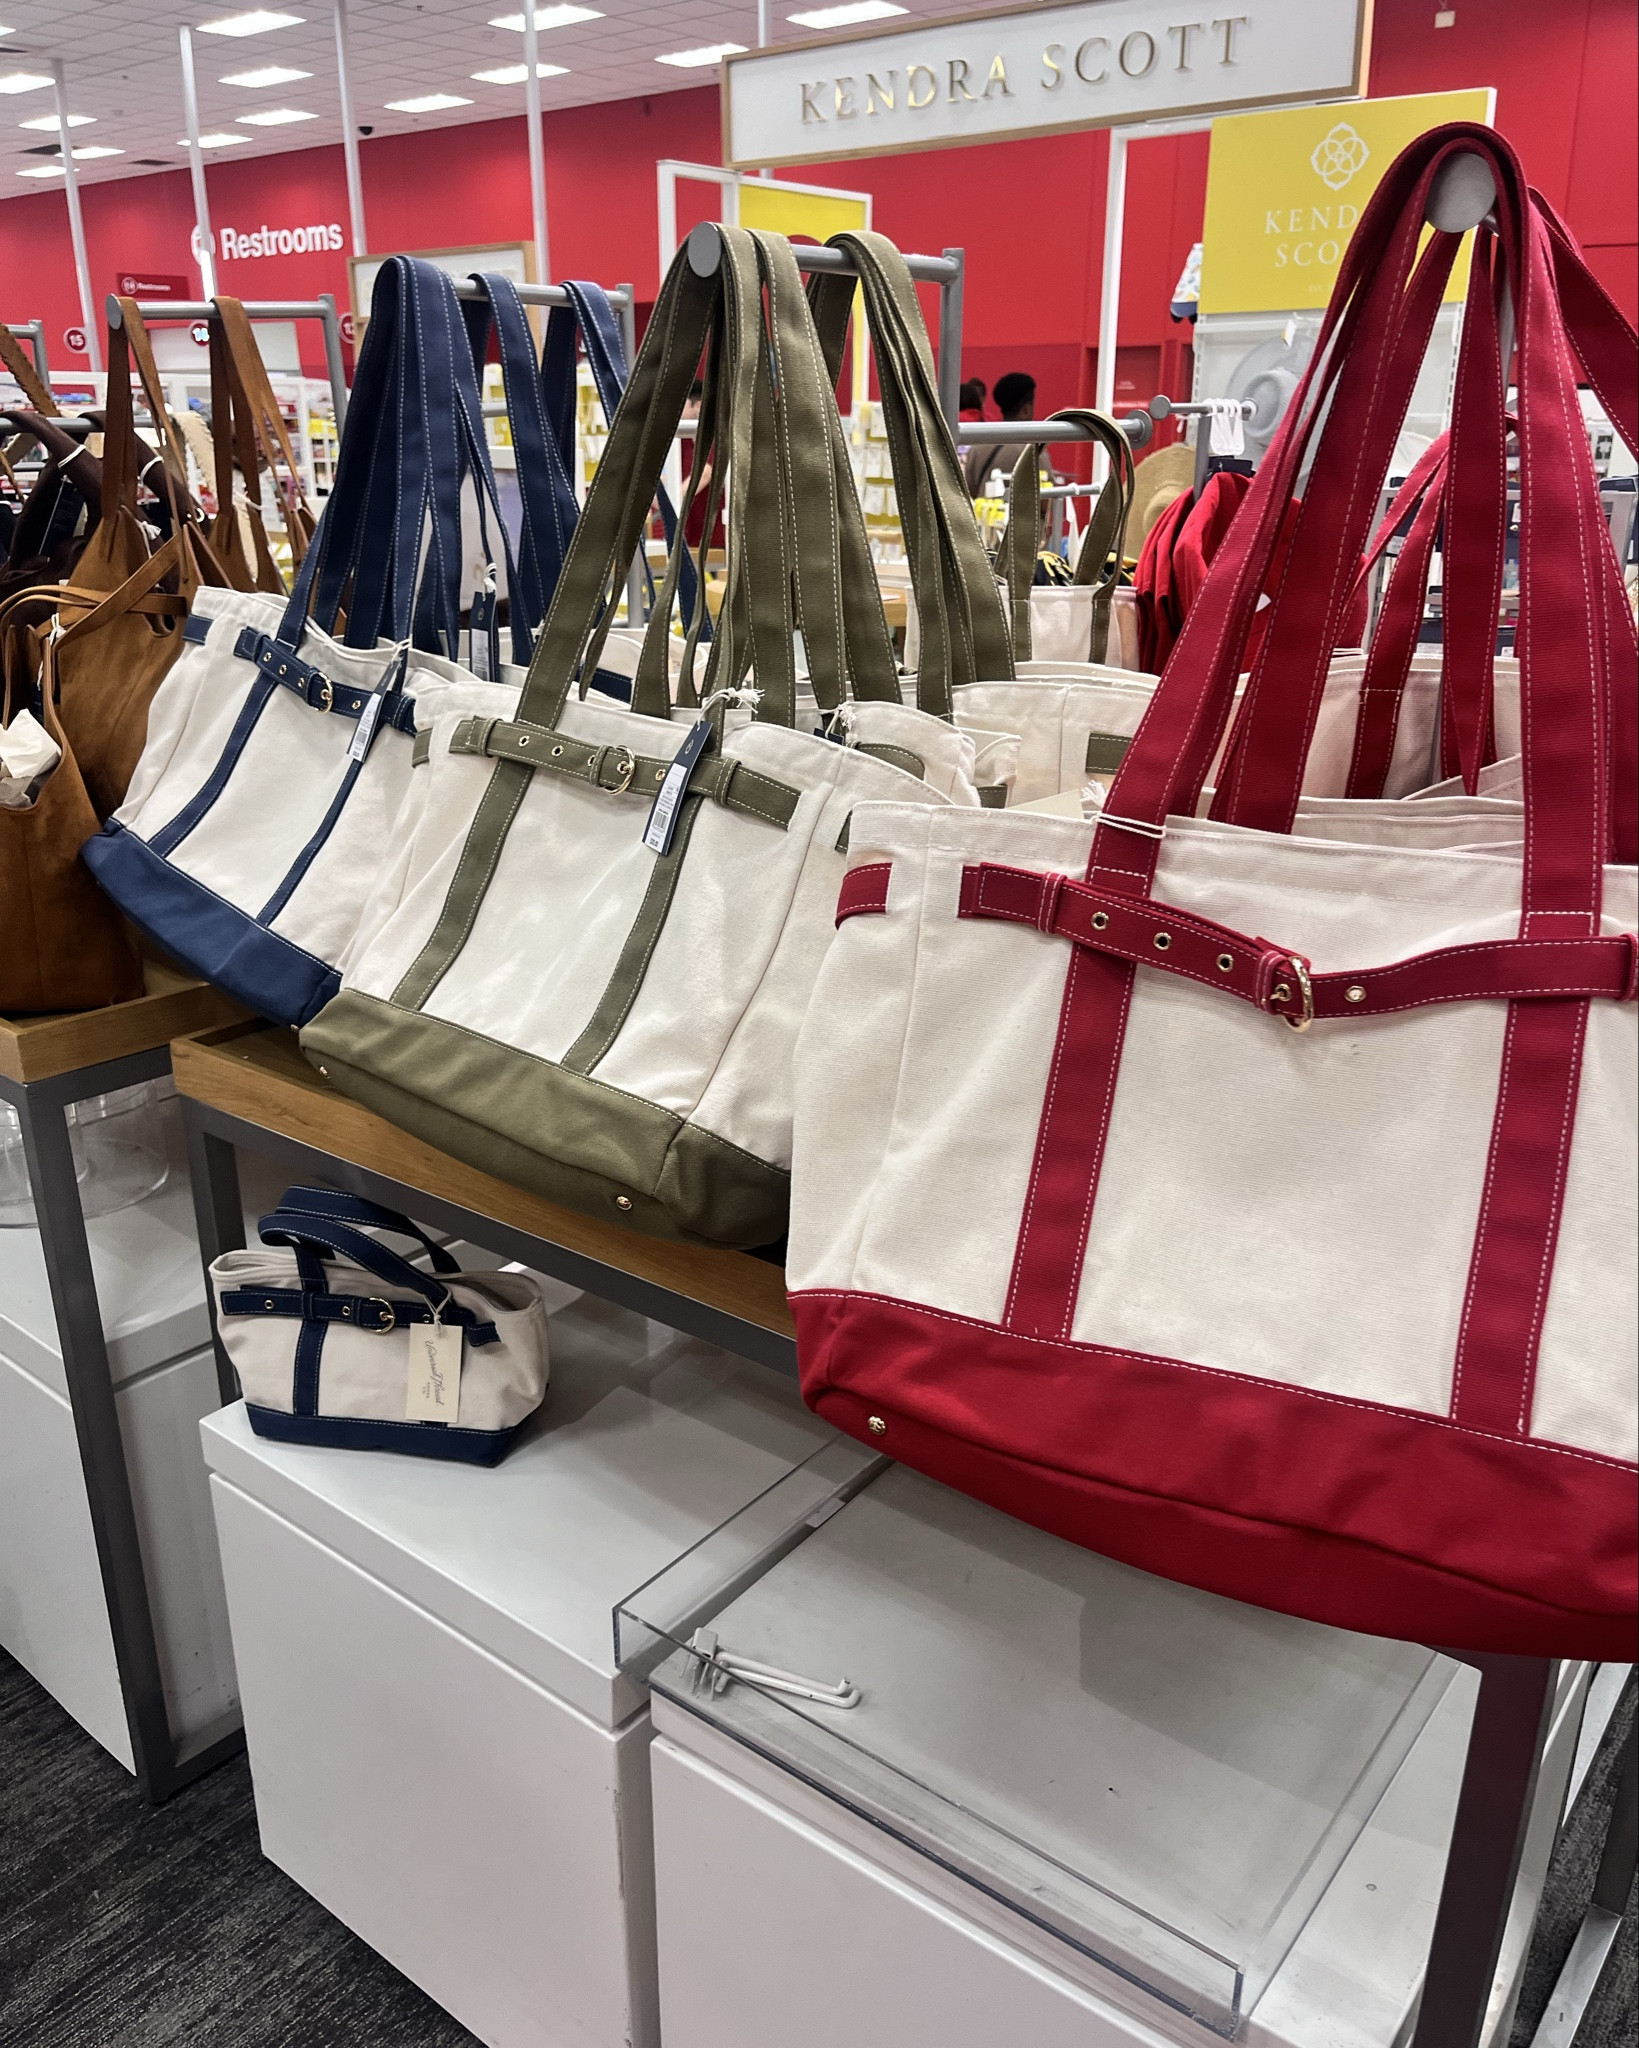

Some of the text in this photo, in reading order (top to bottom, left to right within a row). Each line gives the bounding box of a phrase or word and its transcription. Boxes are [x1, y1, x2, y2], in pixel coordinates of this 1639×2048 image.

[800, 17, 1247, 123] KENDRA SCOTT
[1265, 204, 1358, 234] KEND
[220, 223, 344, 260] Restrooms
[1275, 239, 1350, 268] SCO
[424, 1340, 440, 1377] Universal
[430, 1373, 445, 1405] Thread
